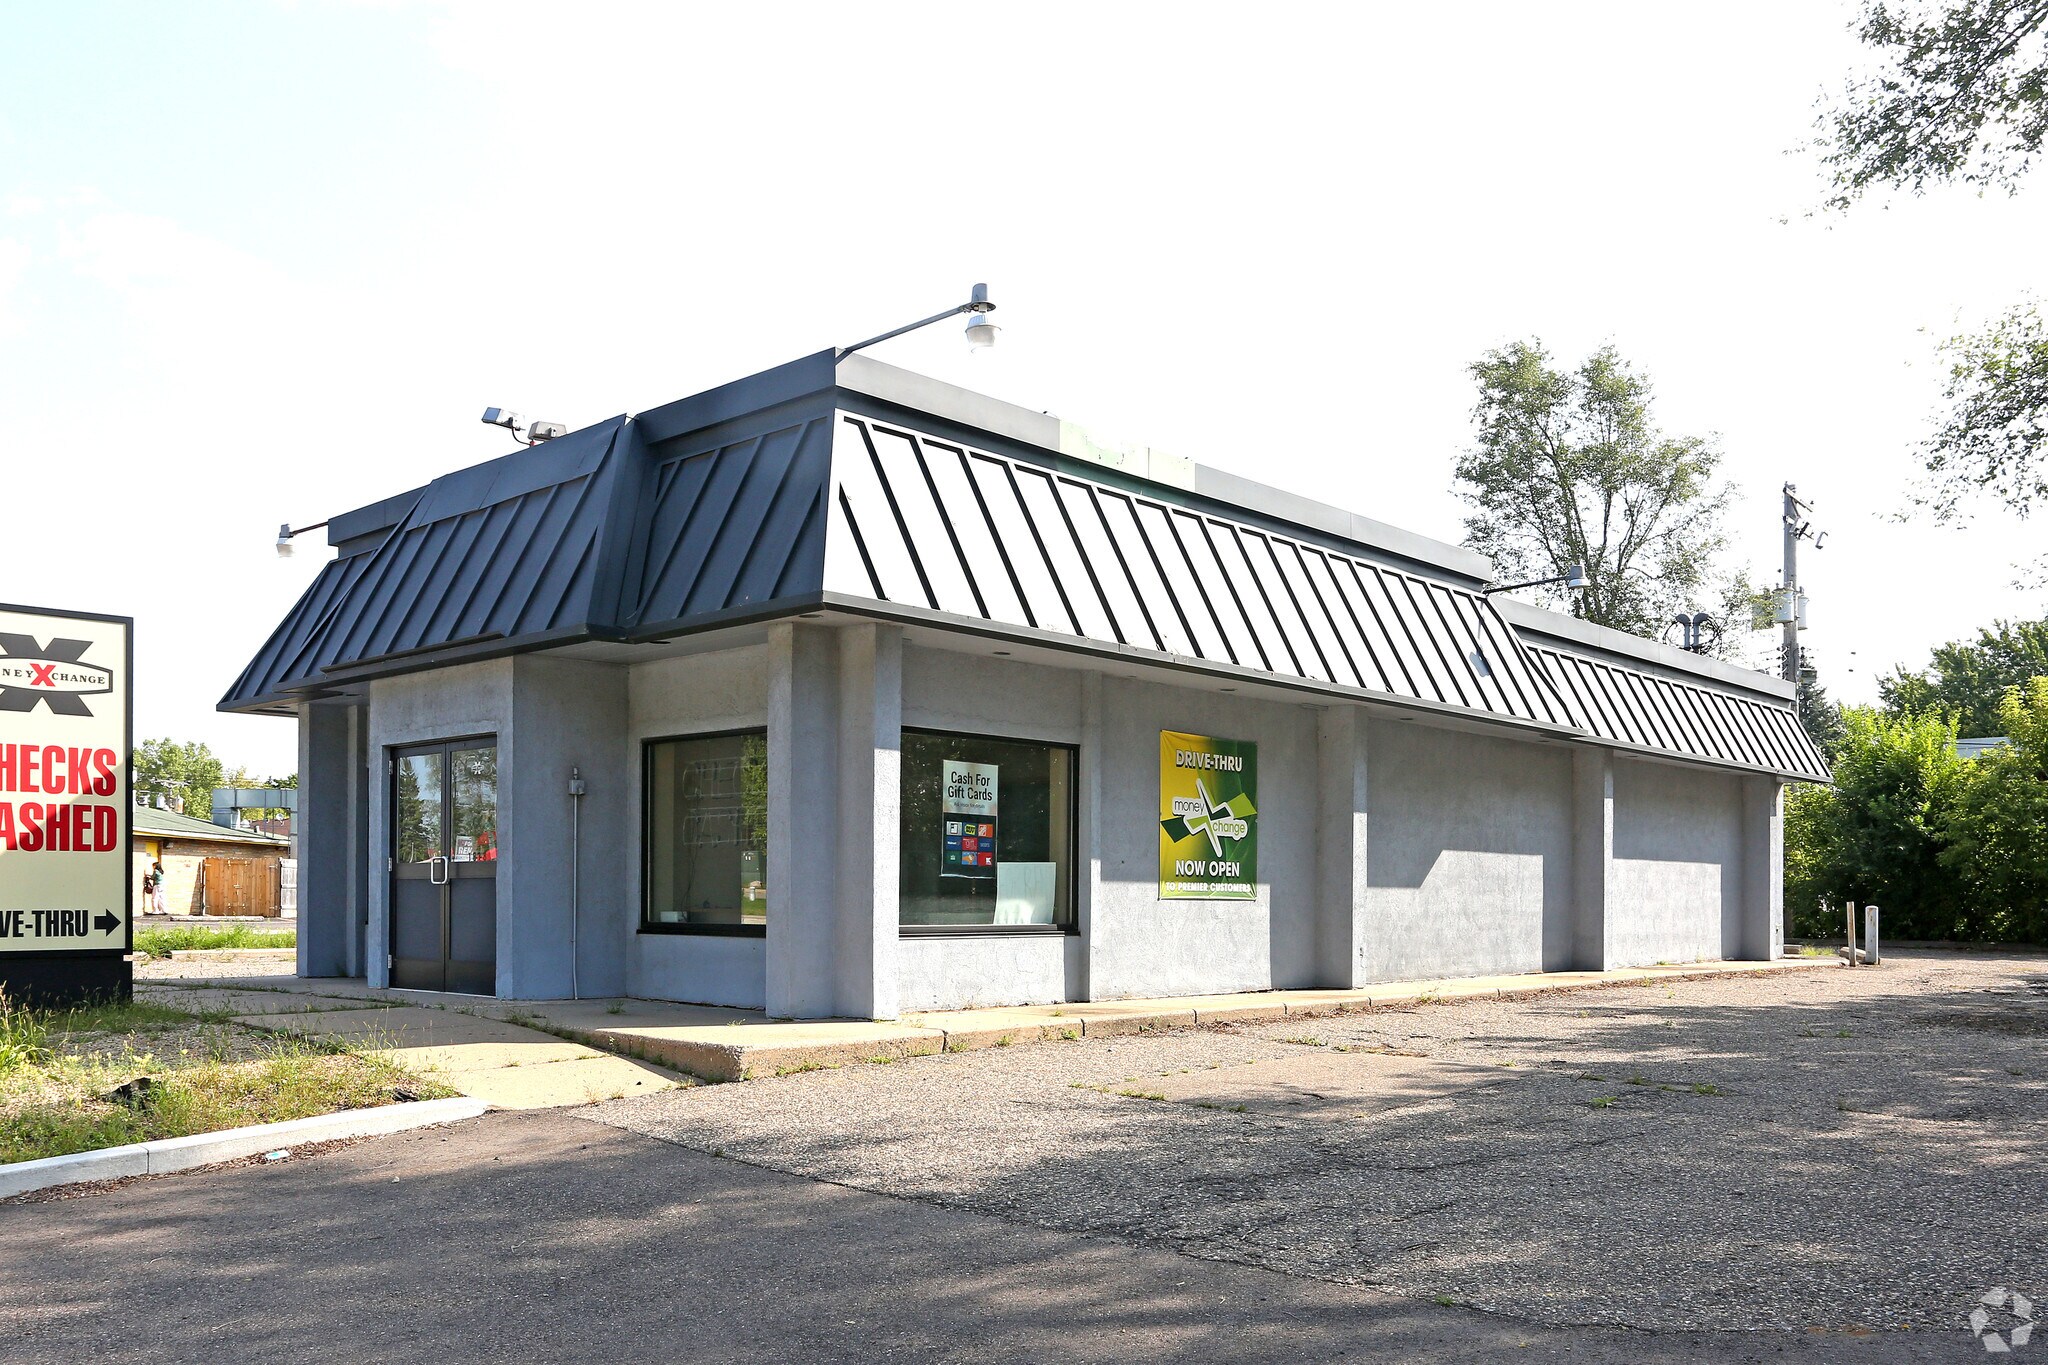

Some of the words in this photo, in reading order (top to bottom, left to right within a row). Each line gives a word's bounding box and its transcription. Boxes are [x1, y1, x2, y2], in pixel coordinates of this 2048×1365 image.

[1176, 749, 1243, 772] DRIVE-THRU
[951, 771, 973, 785] Cash
[975, 773, 990, 786] For
[948, 786, 965, 799] Gift
[967, 788, 993, 801] Cards
[1174, 800, 1204, 815] money
[1212, 820, 1245, 836] change
[1175, 860, 1206, 877] NOW
[1209, 861, 1240, 877] OPEN
[1166, 882, 1176, 891] TO
[1178, 882, 1208, 892] PREMIER
[1210, 883, 1251, 893] CUSTOMERS
